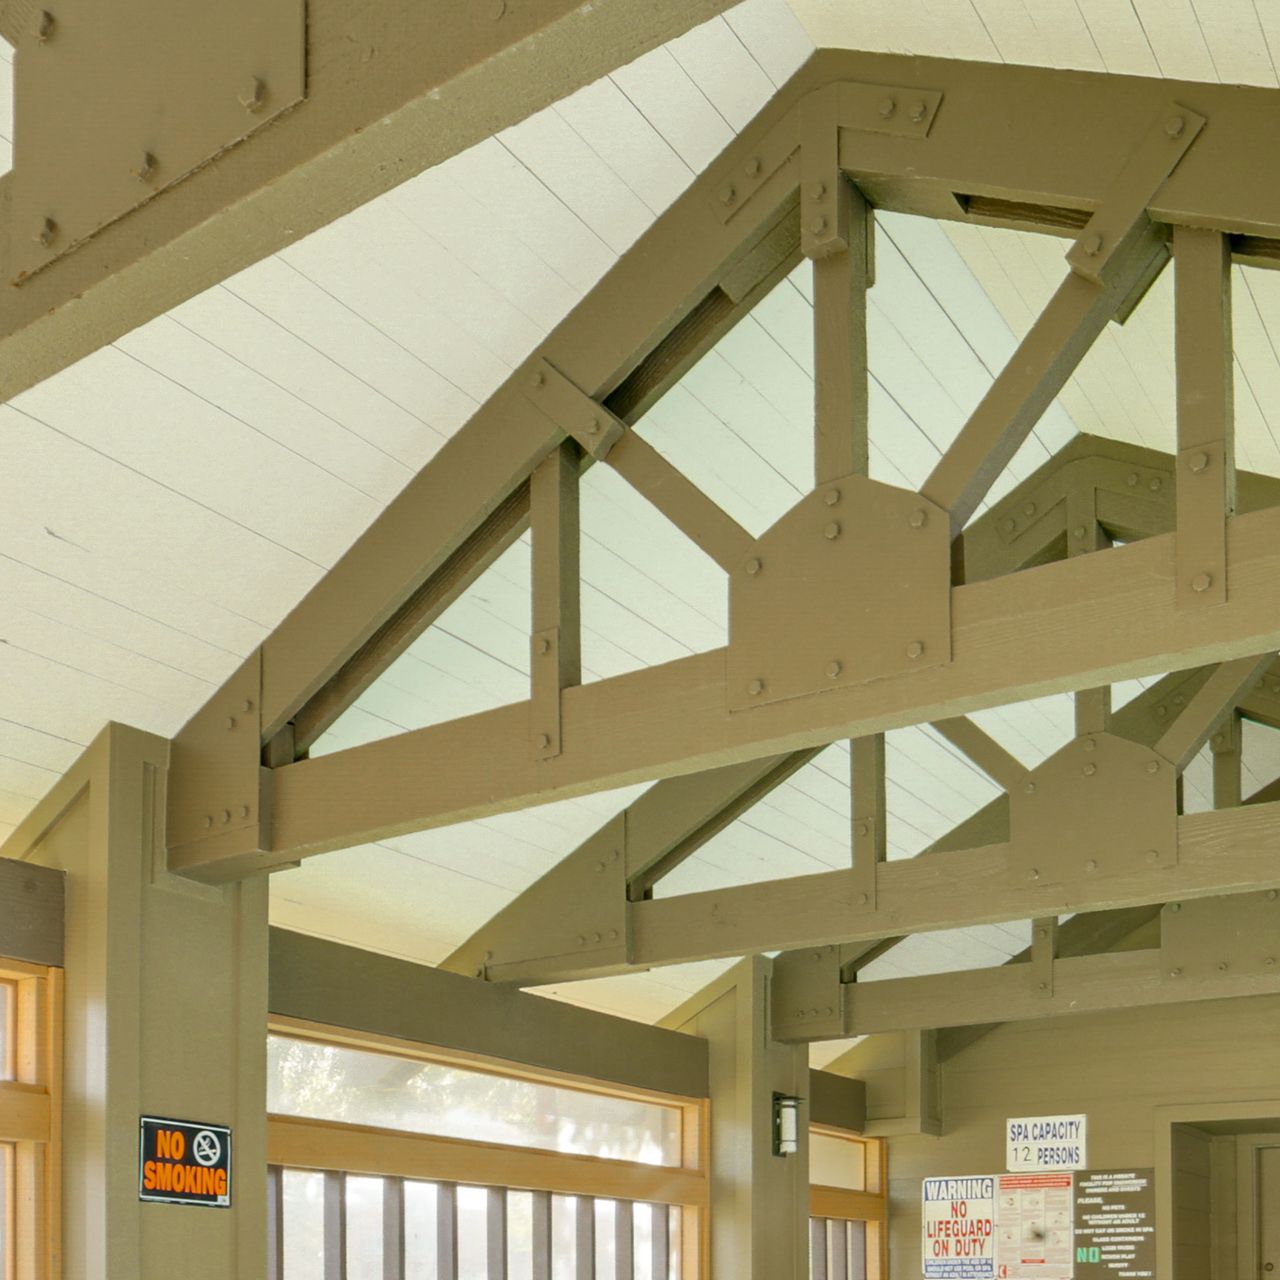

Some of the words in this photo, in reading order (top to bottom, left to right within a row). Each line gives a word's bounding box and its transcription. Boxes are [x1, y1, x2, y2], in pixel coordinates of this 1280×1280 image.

[1011, 1123, 1029, 1142] SPA
[1032, 1120, 1080, 1141] CAPACITY
[157, 1129, 185, 1160] NO
[1038, 1146, 1080, 1165] PERSONS
[144, 1160, 227, 1196] SMOKING
[926, 1179, 993, 1201] WARNING
[951, 1201, 967, 1218] NO
[927, 1219, 992, 1239] LIFEGUARD
[933, 1239, 949, 1257] ON
[955, 1238, 985, 1256] DUTY
[1077, 1247, 1100, 1263] NO
